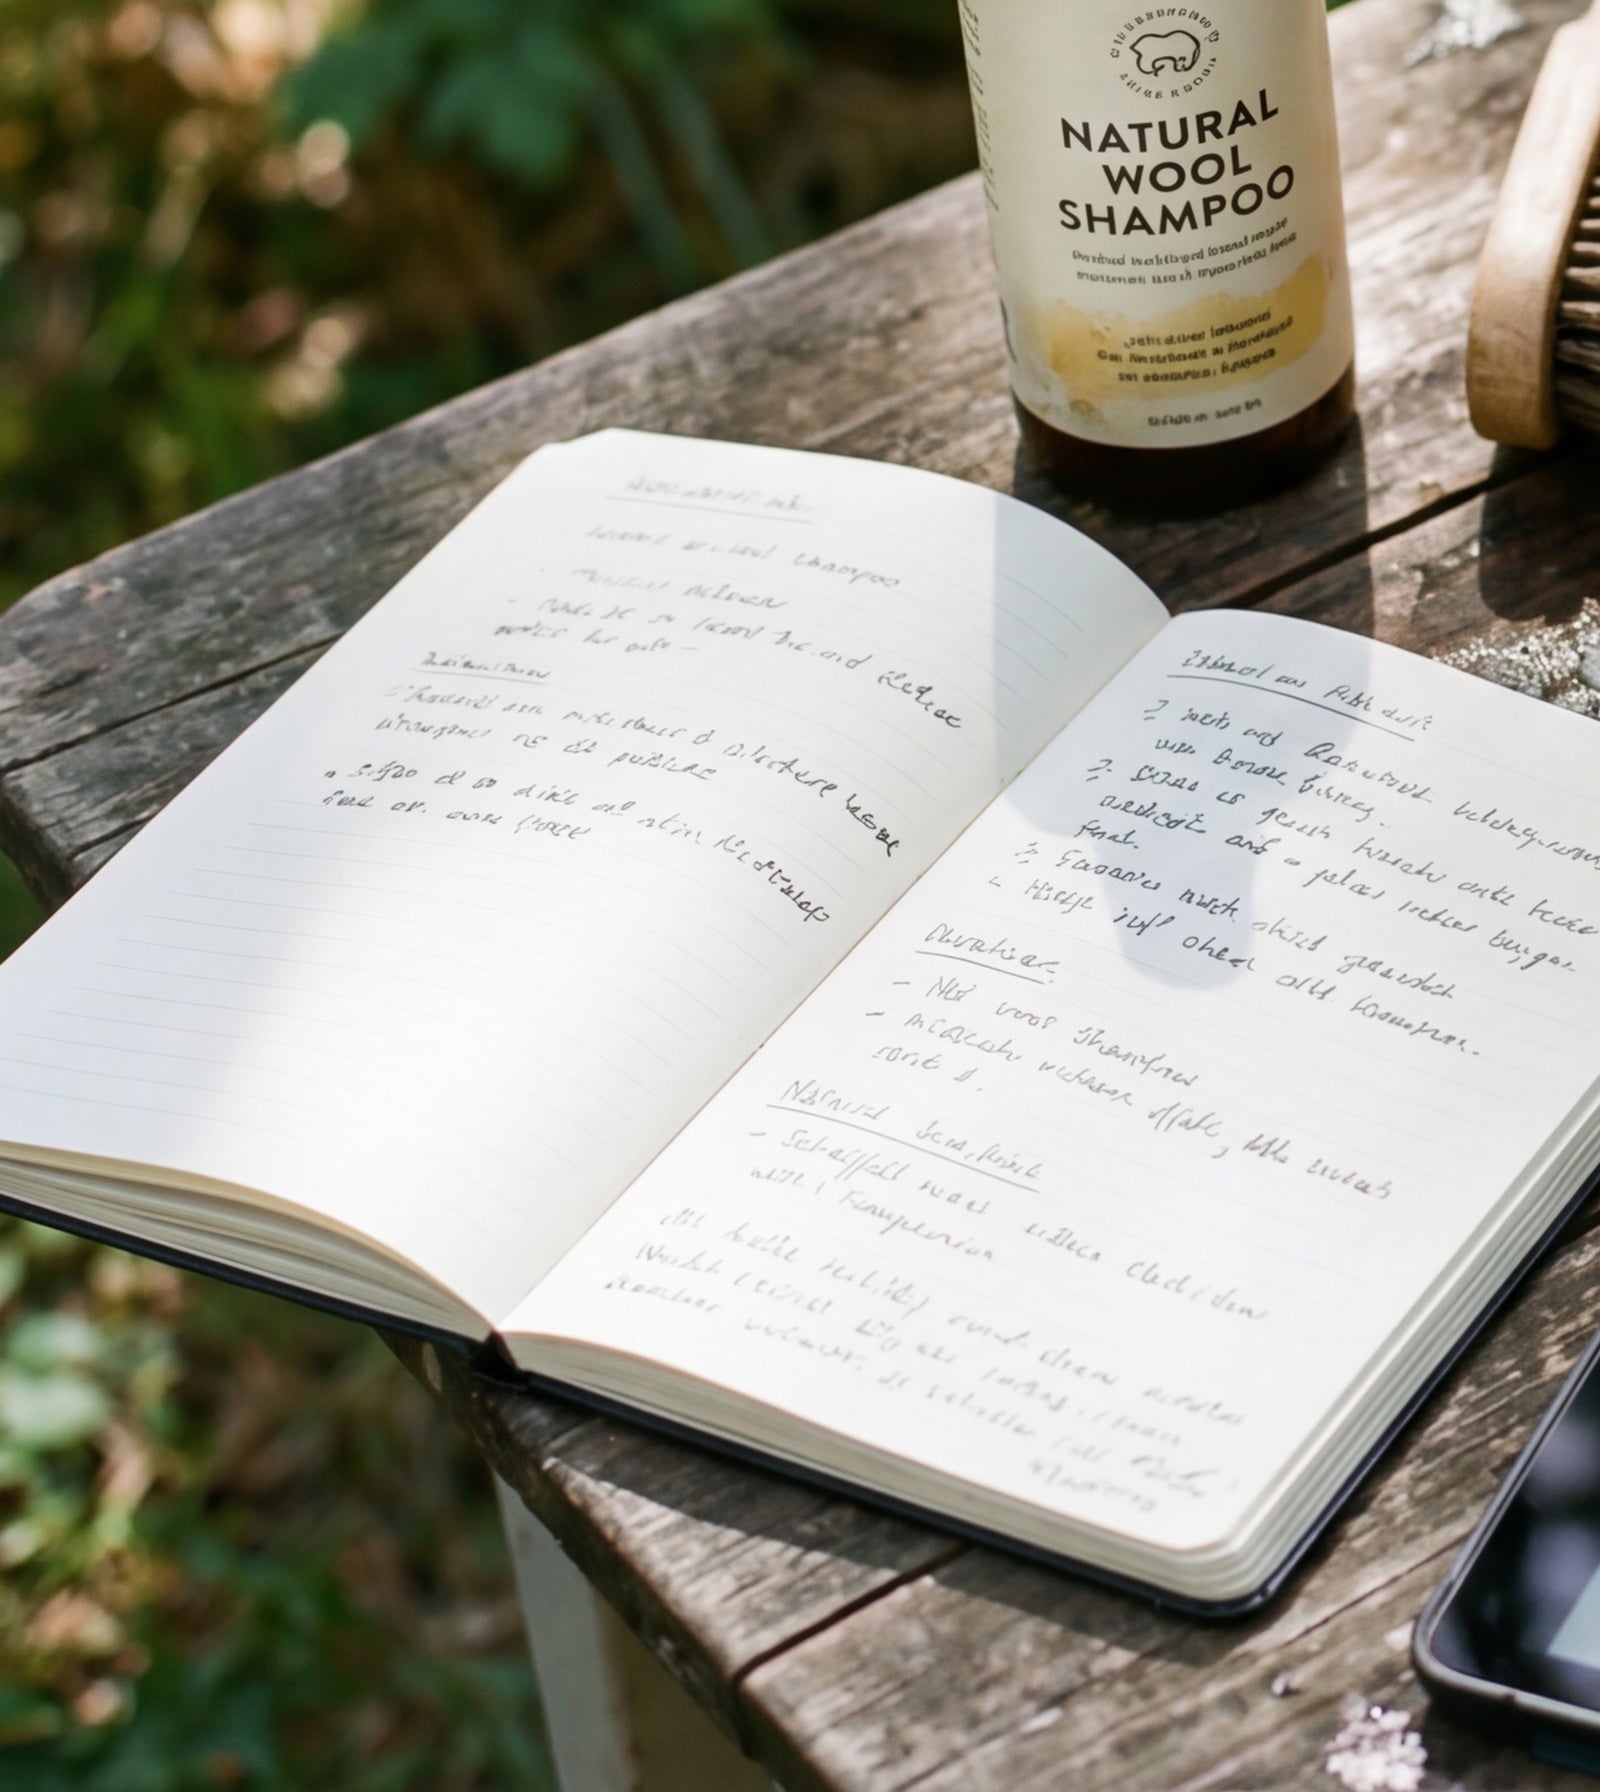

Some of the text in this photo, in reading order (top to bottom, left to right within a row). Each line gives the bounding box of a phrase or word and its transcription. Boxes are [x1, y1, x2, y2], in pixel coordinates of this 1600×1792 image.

[1060, 88, 1280, 153] NATURAL
[1057, 164, 1296, 236] SHAMPOO
[1101, 144, 1253, 196] WOOL
